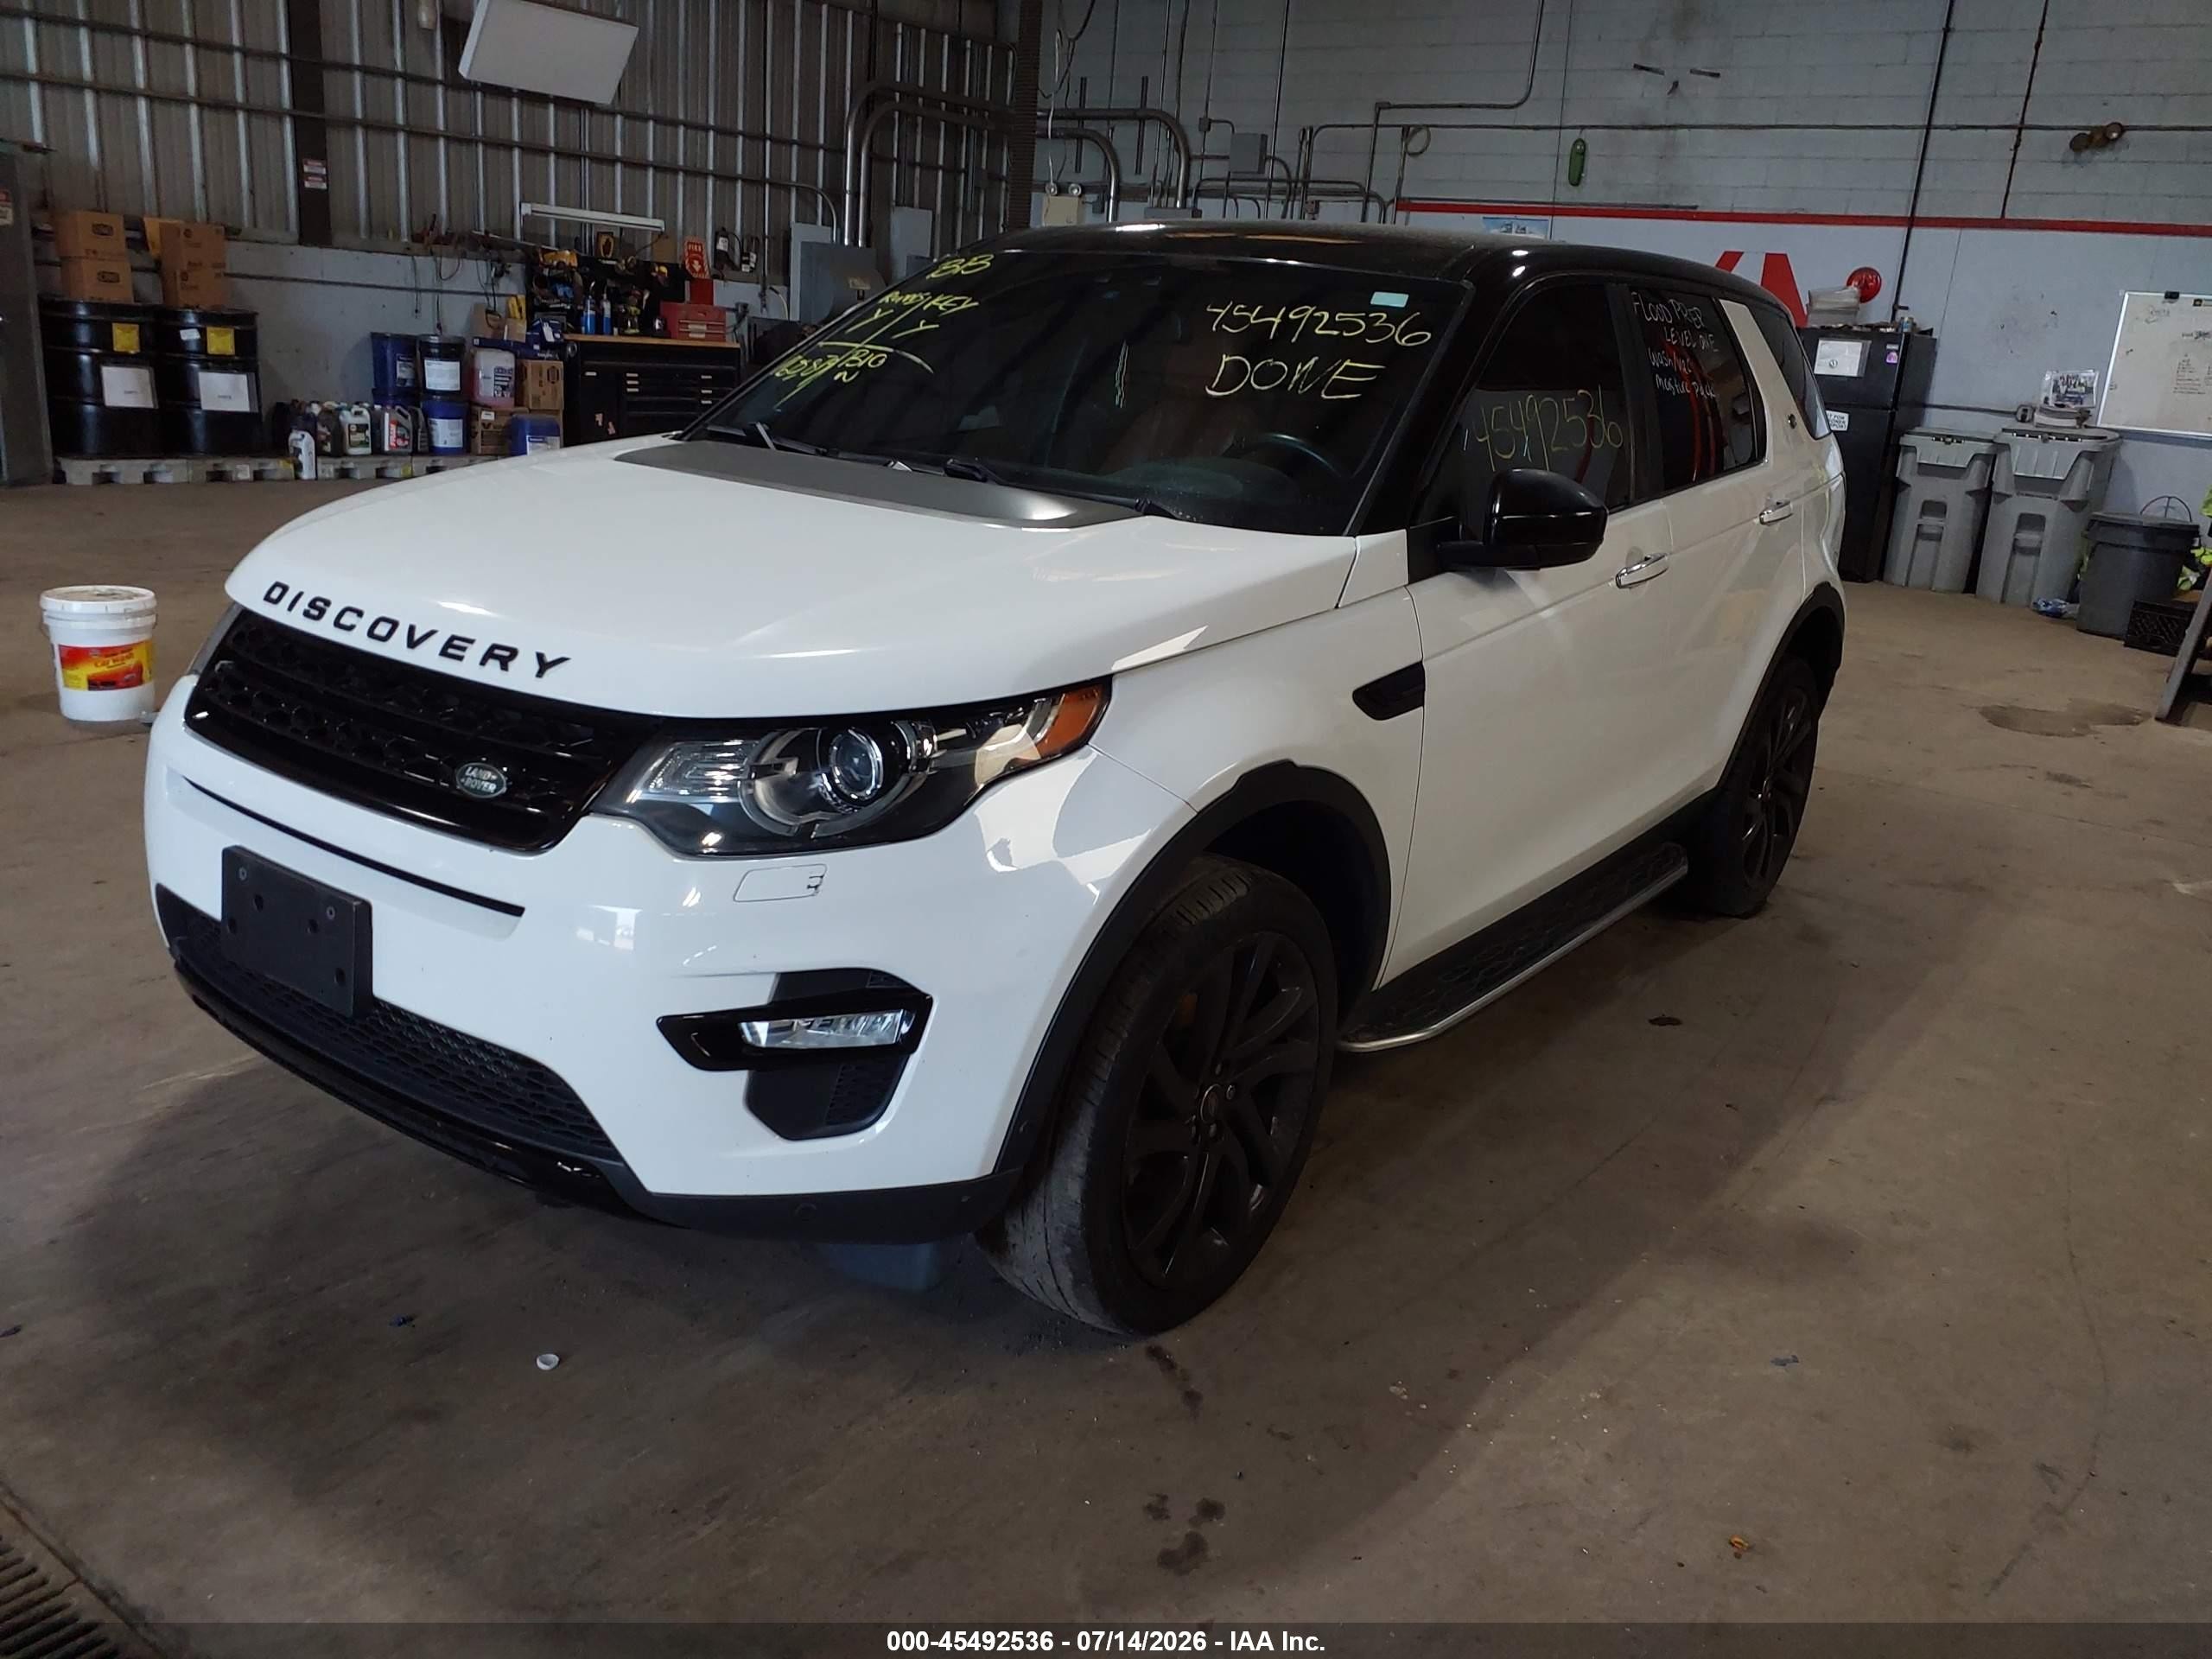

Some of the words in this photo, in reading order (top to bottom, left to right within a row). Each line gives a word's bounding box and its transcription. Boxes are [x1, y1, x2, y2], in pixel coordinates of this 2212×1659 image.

[1630, 291, 1673, 324] FLOOD
[1663, 326, 1697, 348] LEVEL
[1205, 353, 1386, 400] DONE
[262, 580, 571, 679] DISCOVERY
[464, 777, 498, 793] ROVER
[465, 766, 492, 780] LAND
